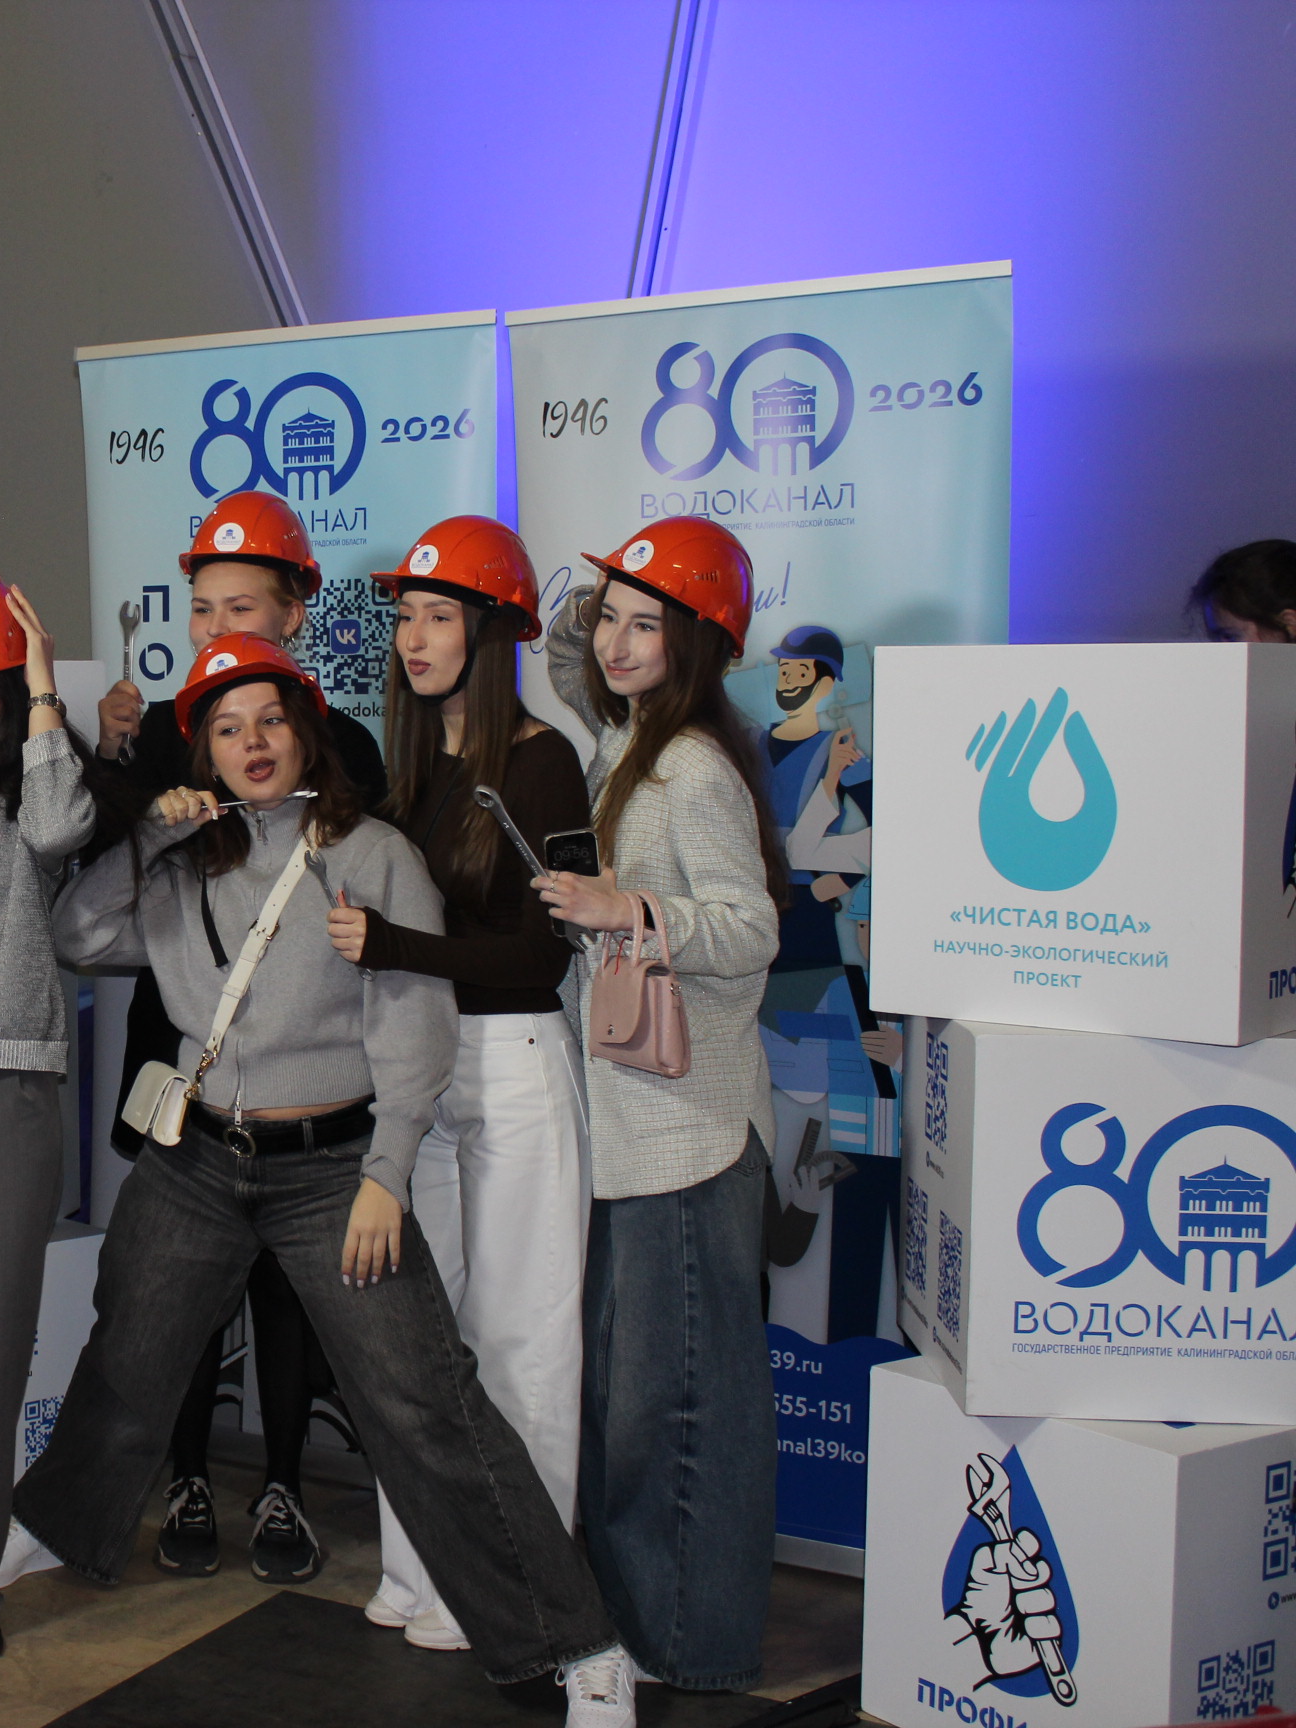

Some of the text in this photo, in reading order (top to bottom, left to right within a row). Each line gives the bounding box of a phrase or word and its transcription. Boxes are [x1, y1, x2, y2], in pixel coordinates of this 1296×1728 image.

[640, 332, 855, 482] 80
[868, 371, 983, 412] 2026
[380, 408, 475, 444] 2026
[542, 397, 609, 438] 1946
[109, 427, 165, 464] 1946
[640, 482, 855, 520] ВОДОКАНАЛ
[824, 517, 855, 527] ОБЛАСТИ
[342, 537, 367, 546] ОБЛАСТИ
[950, 905, 1151, 936] «ЧИСТАЯ ВОДА»
[934, 939, 1169, 968] НАУЧНО-ЭКОЛОГИЧЕСКИЙ
[1013, 970, 1082, 988] ПРОЕКТ
[1269, 966, 1296, 999] ПРО
[770, 1350, 823, 1374] 39.ru
[1012, 1343, 1296, 1361] ГОСУДАРСТВЕННОЕ ПРЕДПРИЯТИЕ КАЛИНИНГРАДСКОЙ ОБЛ
[777, 1437, 866, 1465] nal39ko
